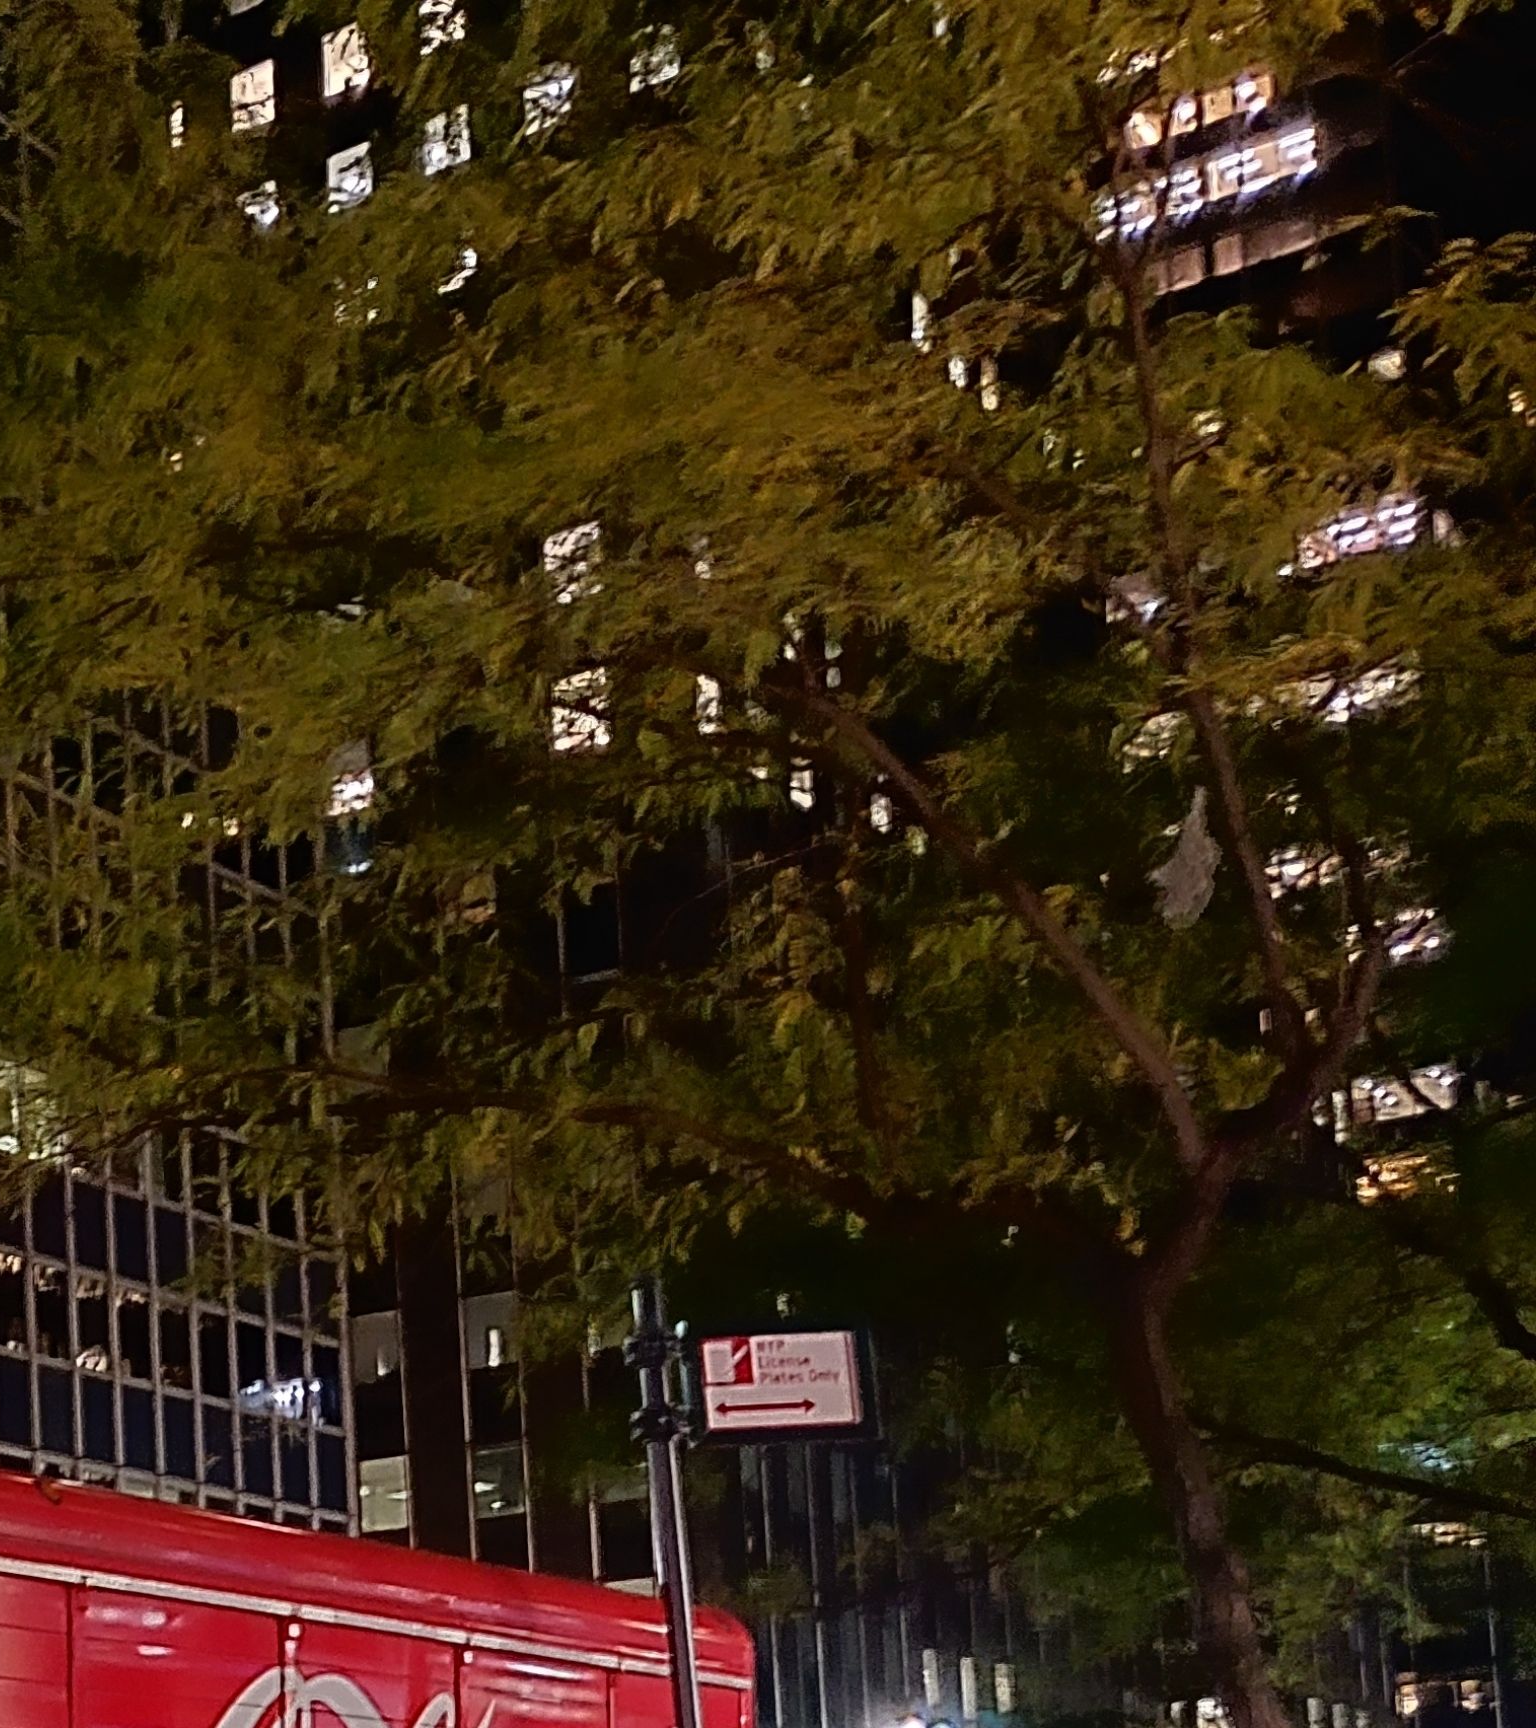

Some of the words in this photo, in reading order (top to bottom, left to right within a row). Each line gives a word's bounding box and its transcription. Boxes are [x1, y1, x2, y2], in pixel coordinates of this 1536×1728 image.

[758, 1356, 811, 1368] License
[760, 1370, 804, 1384] Plates
[809, 1368, 841, 1384] Only
